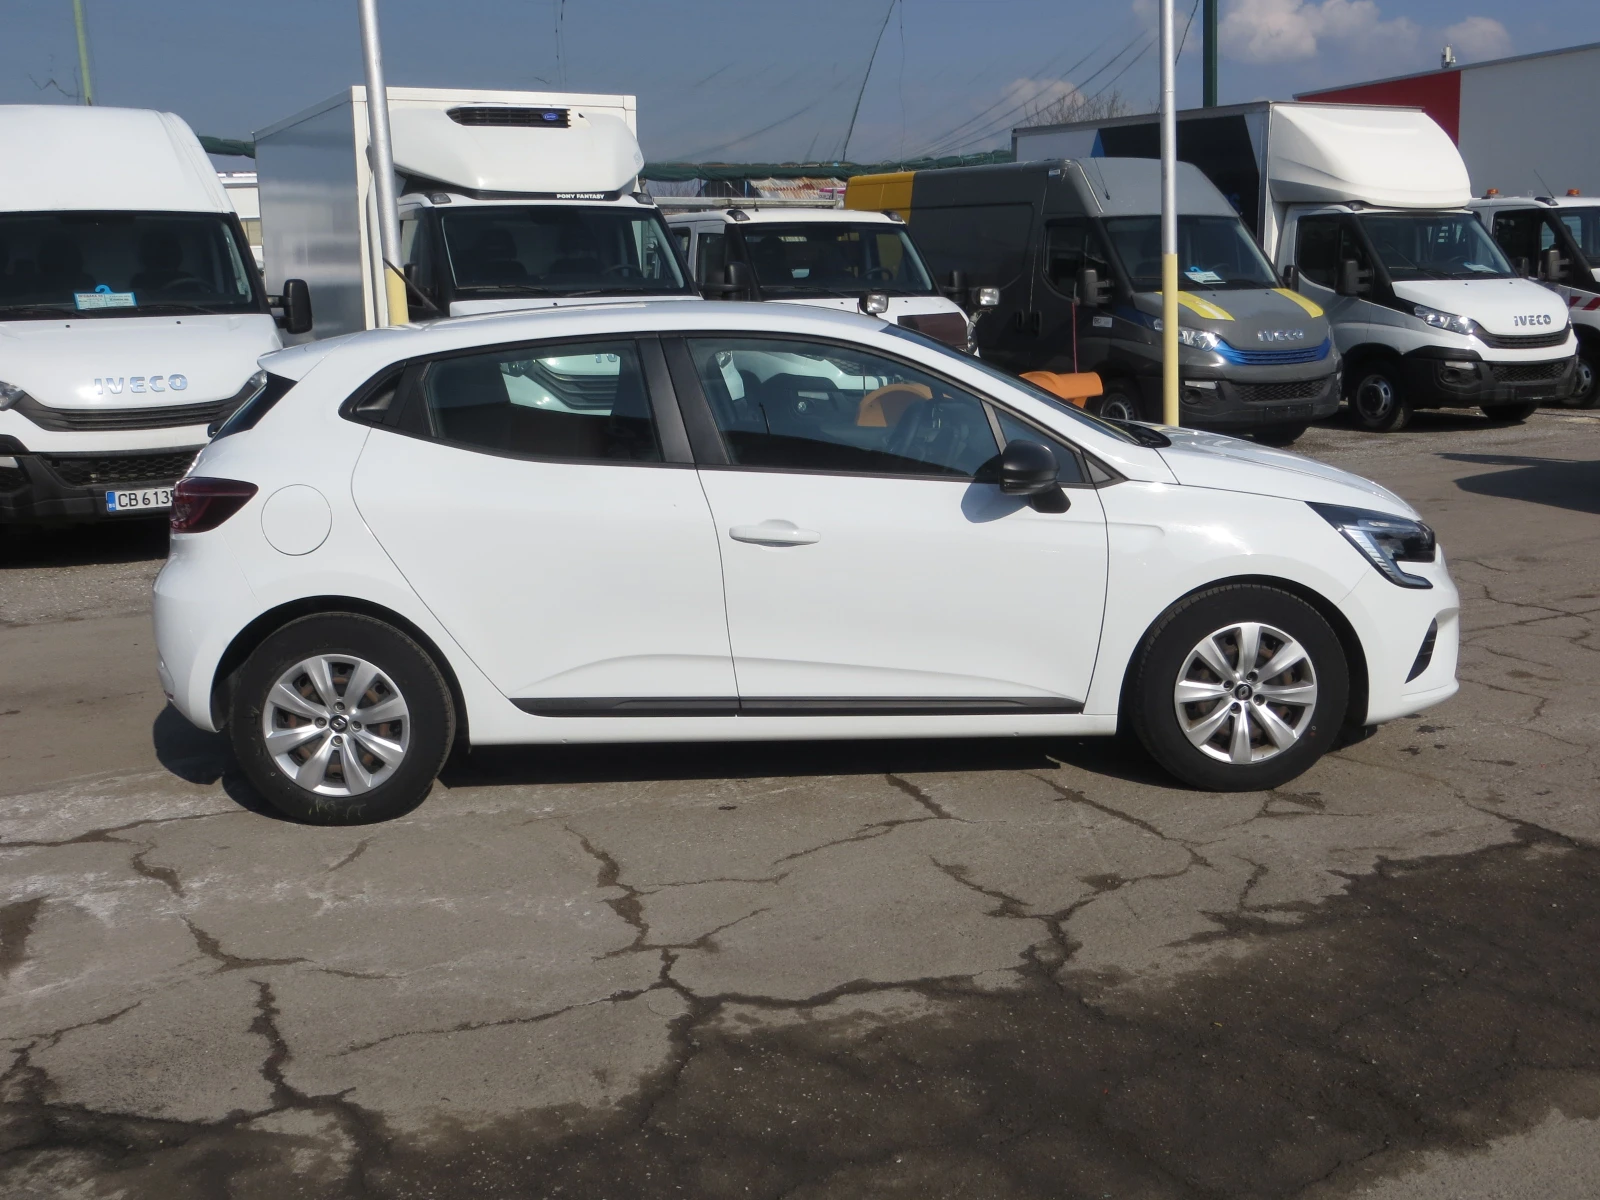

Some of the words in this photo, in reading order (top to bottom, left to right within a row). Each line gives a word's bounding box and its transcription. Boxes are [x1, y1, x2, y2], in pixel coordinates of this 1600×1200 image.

[1513, 314, 1552, 327] IVECO
[1257, 328, 1304, 342] IVECO
[94, 373, 188, 395] IVECO
